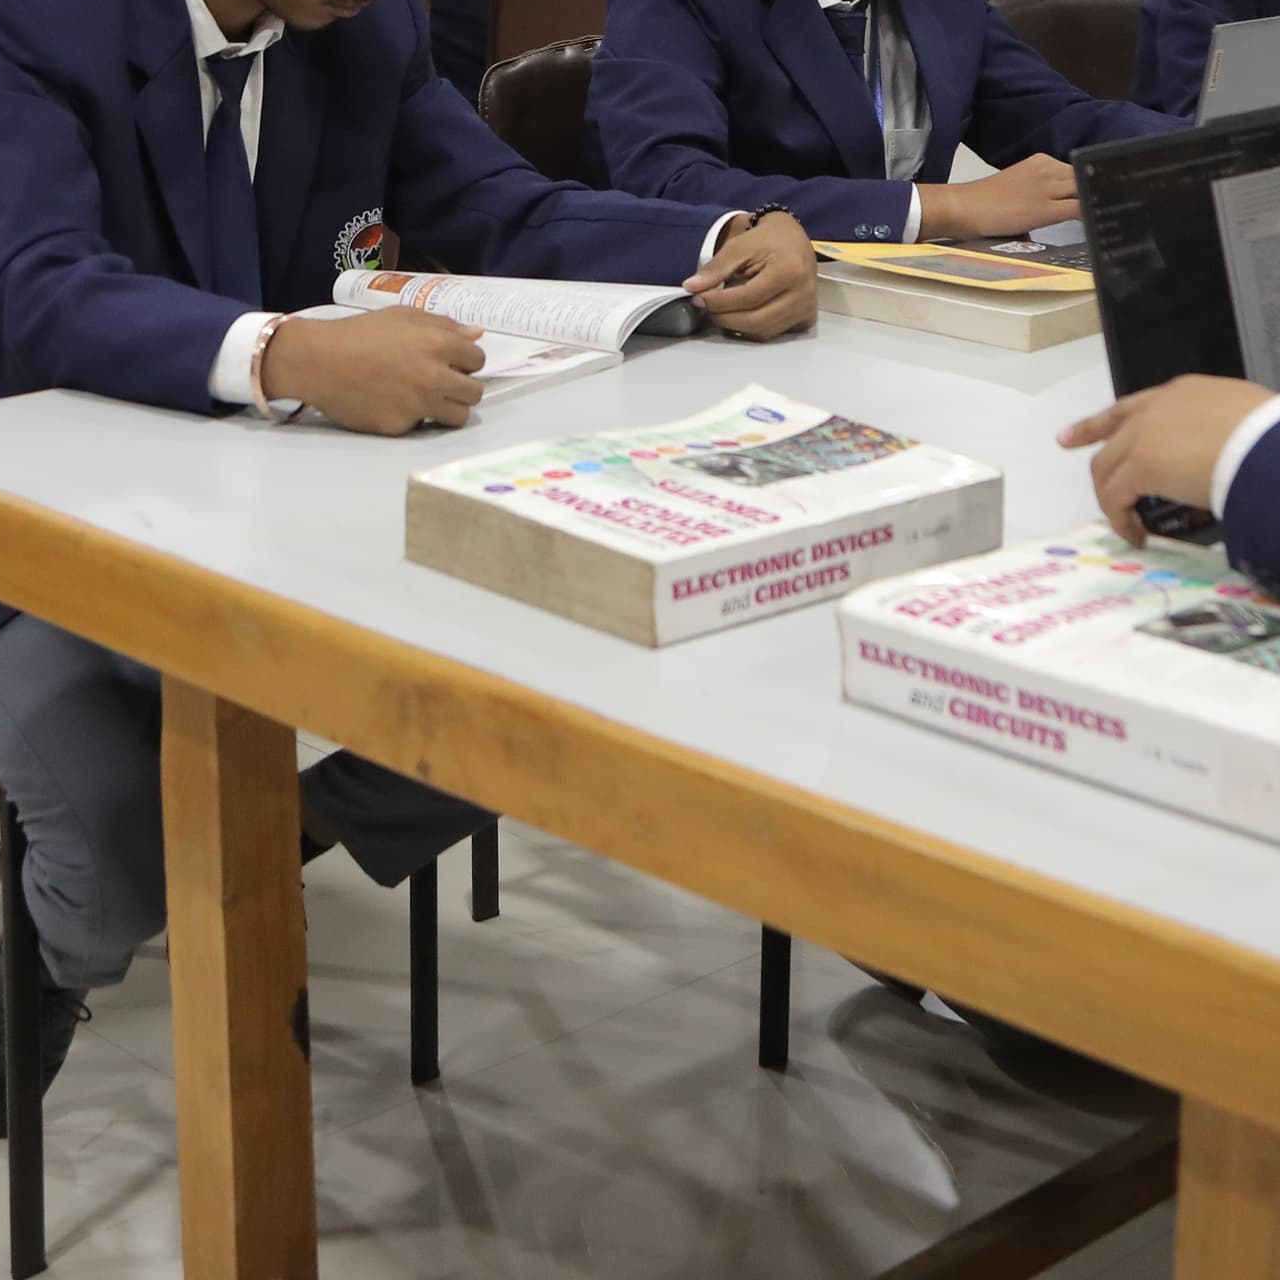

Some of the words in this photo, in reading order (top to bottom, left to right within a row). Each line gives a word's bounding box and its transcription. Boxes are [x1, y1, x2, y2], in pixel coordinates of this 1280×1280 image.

[672, 549, 805, 602] ELECTRONIC
[811, 524, 894, 563] DEVICES
[721, 594, 751, 615] and
[754, 562, 851, 605] CIRCUITS
[858, 640, 1011, 705] ELECTRONIC
[1016, 688, 1128, 741] DEVICES
[910, 689, 945, 714] and
[948, 695, 1067, 753] CIRCUITS
